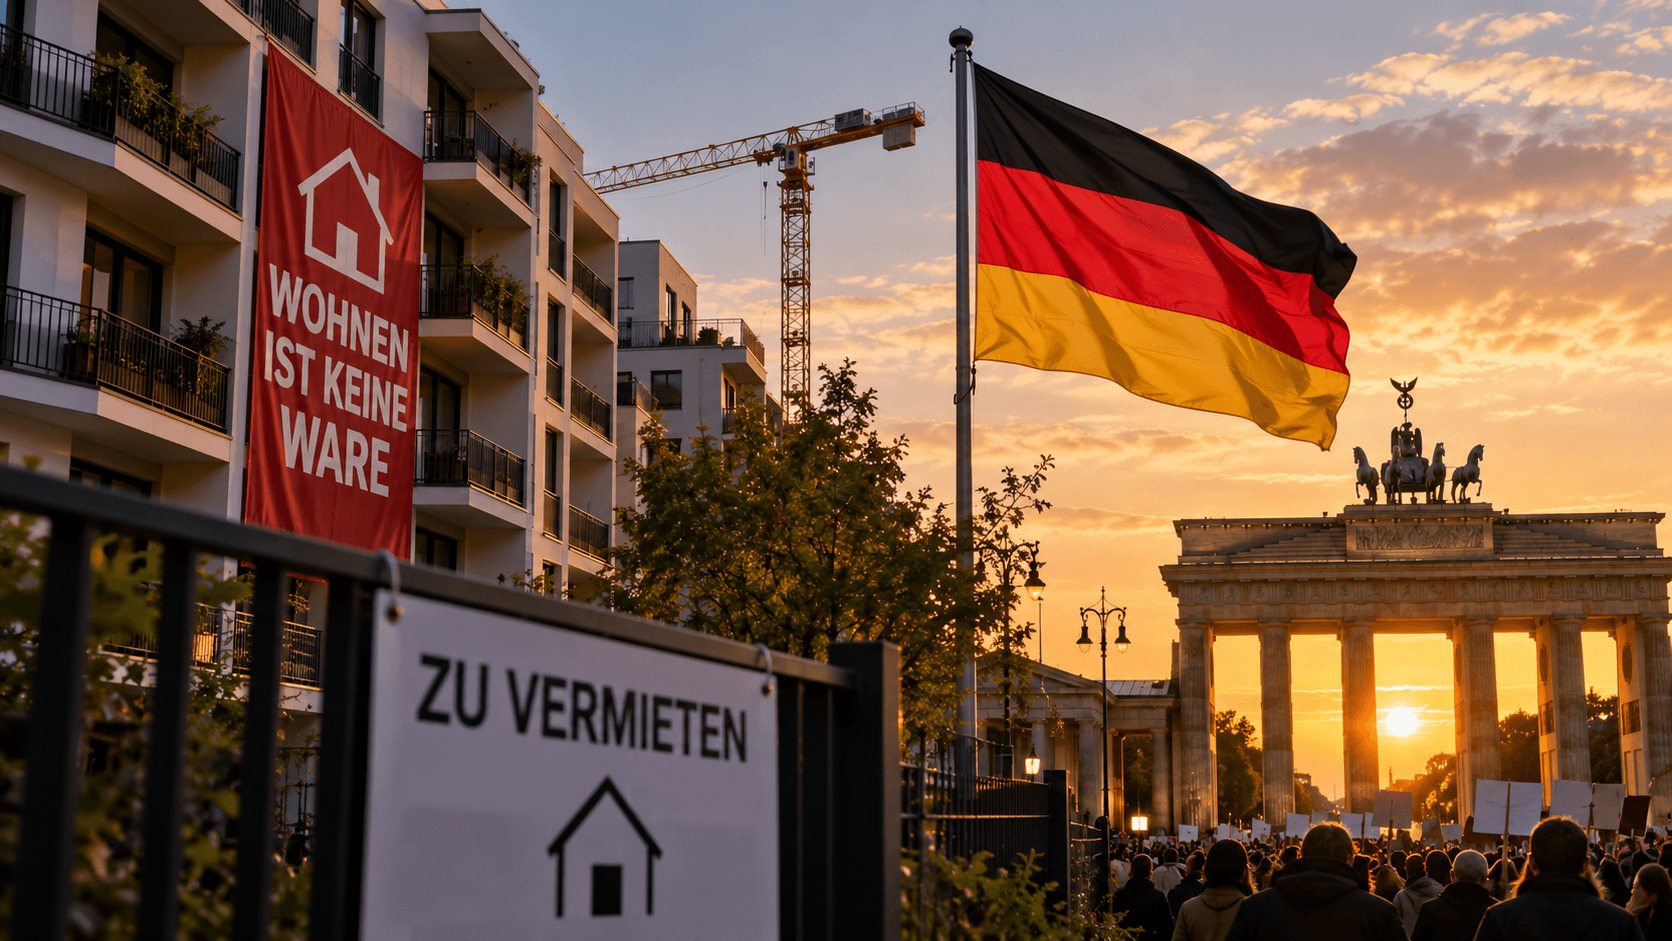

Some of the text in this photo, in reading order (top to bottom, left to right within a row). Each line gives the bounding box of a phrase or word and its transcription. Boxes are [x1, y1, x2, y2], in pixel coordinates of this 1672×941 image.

[269, 262, 409, 374] WOHNEN
[264, 329, 408, 433] IST KEINE
[280, 403, 391, 498] WARE
[416, 652, 747, 763] ZU VERMIETEN
